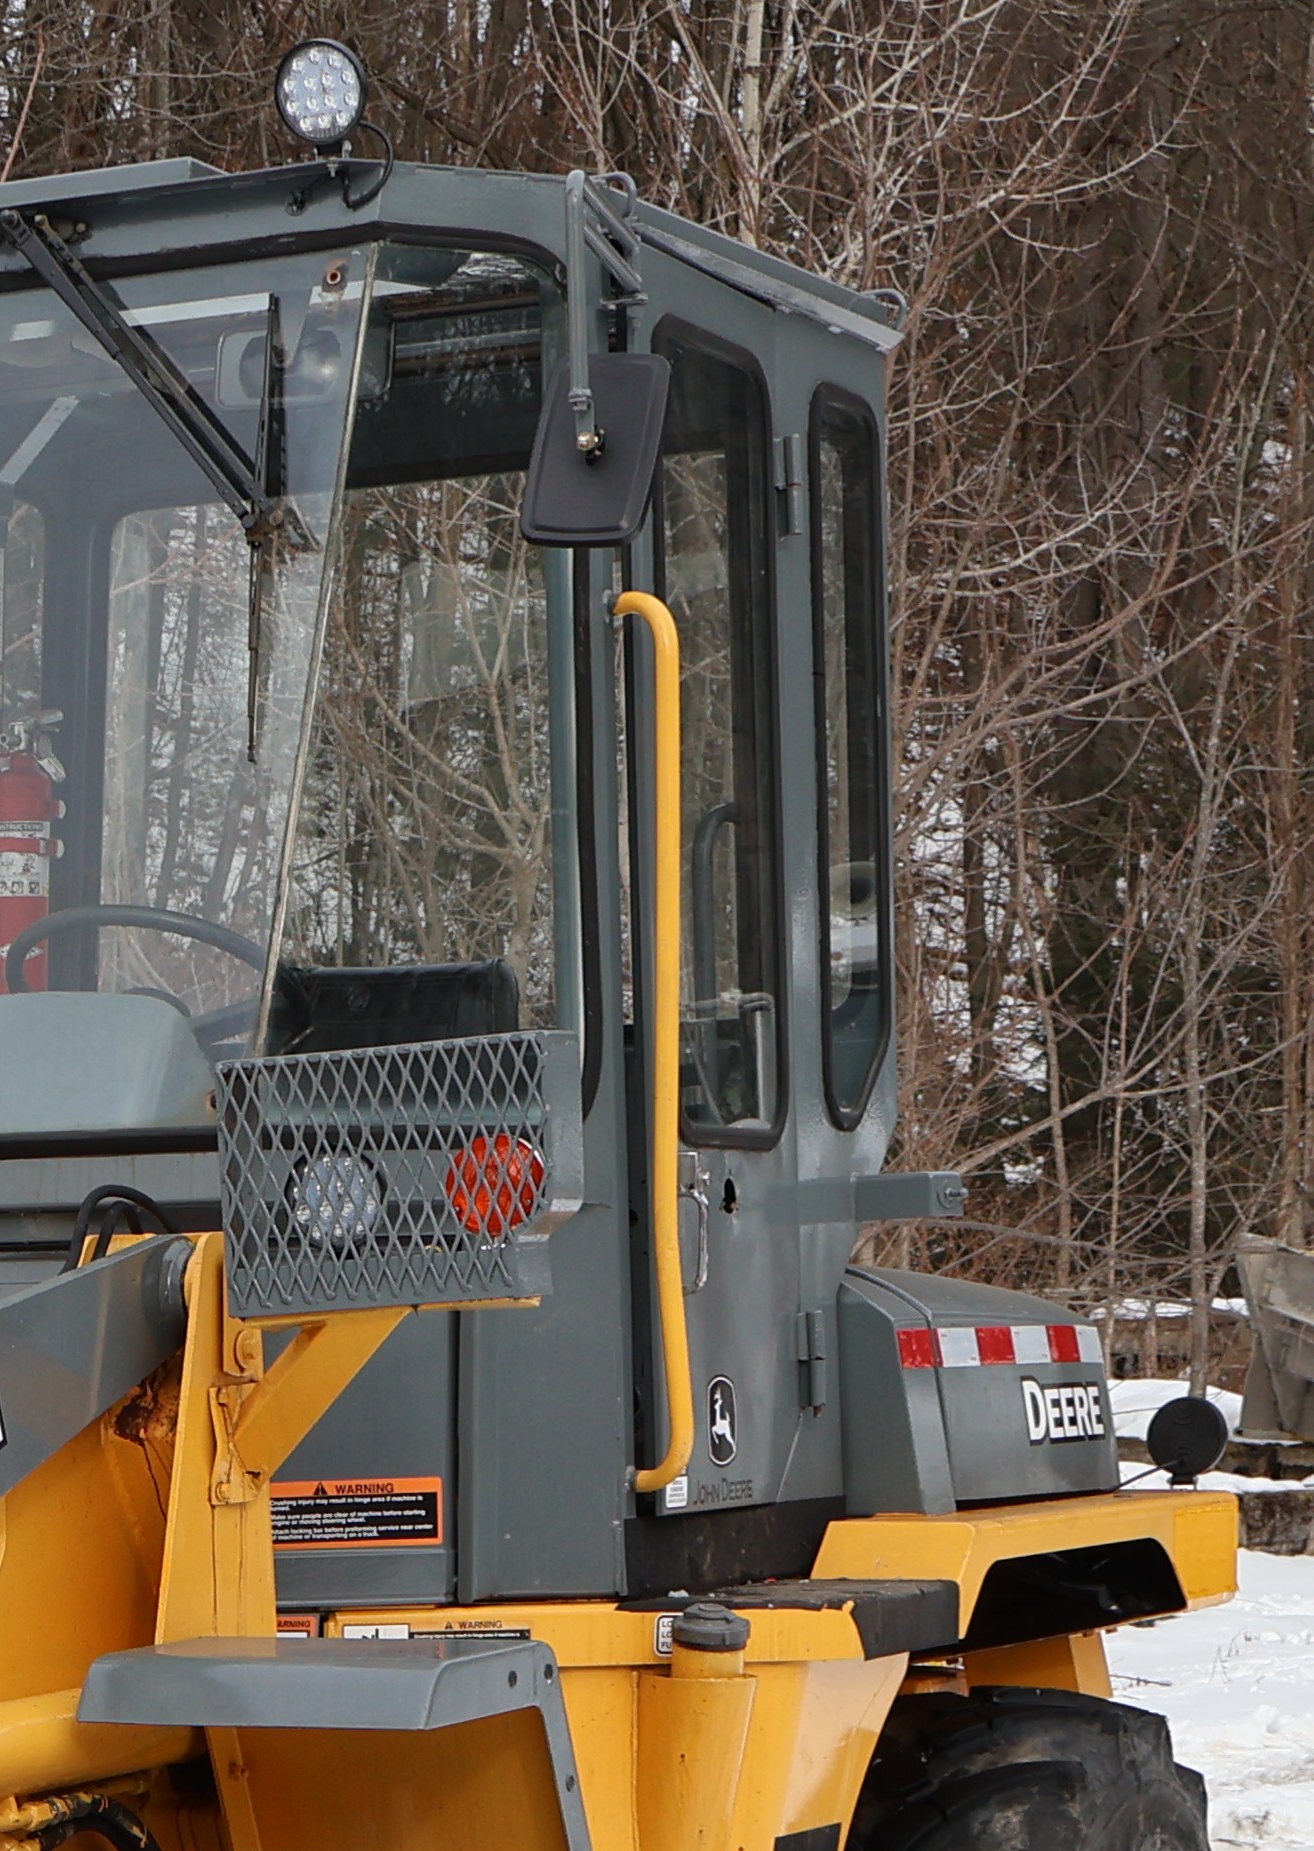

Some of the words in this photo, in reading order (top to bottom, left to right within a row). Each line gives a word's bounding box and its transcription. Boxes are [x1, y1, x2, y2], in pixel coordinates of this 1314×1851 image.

[1021, 1377, 1106, 1445] DEERE
[335, 1483, 394, 1495] WARNING
[693, 1481, 720, 1505] JOHN
[721, 1477, 753, 1501] DEERE
[277, 1619, 311, 1629] ARNING
[458, 1620, 503, 1630] WARNING
